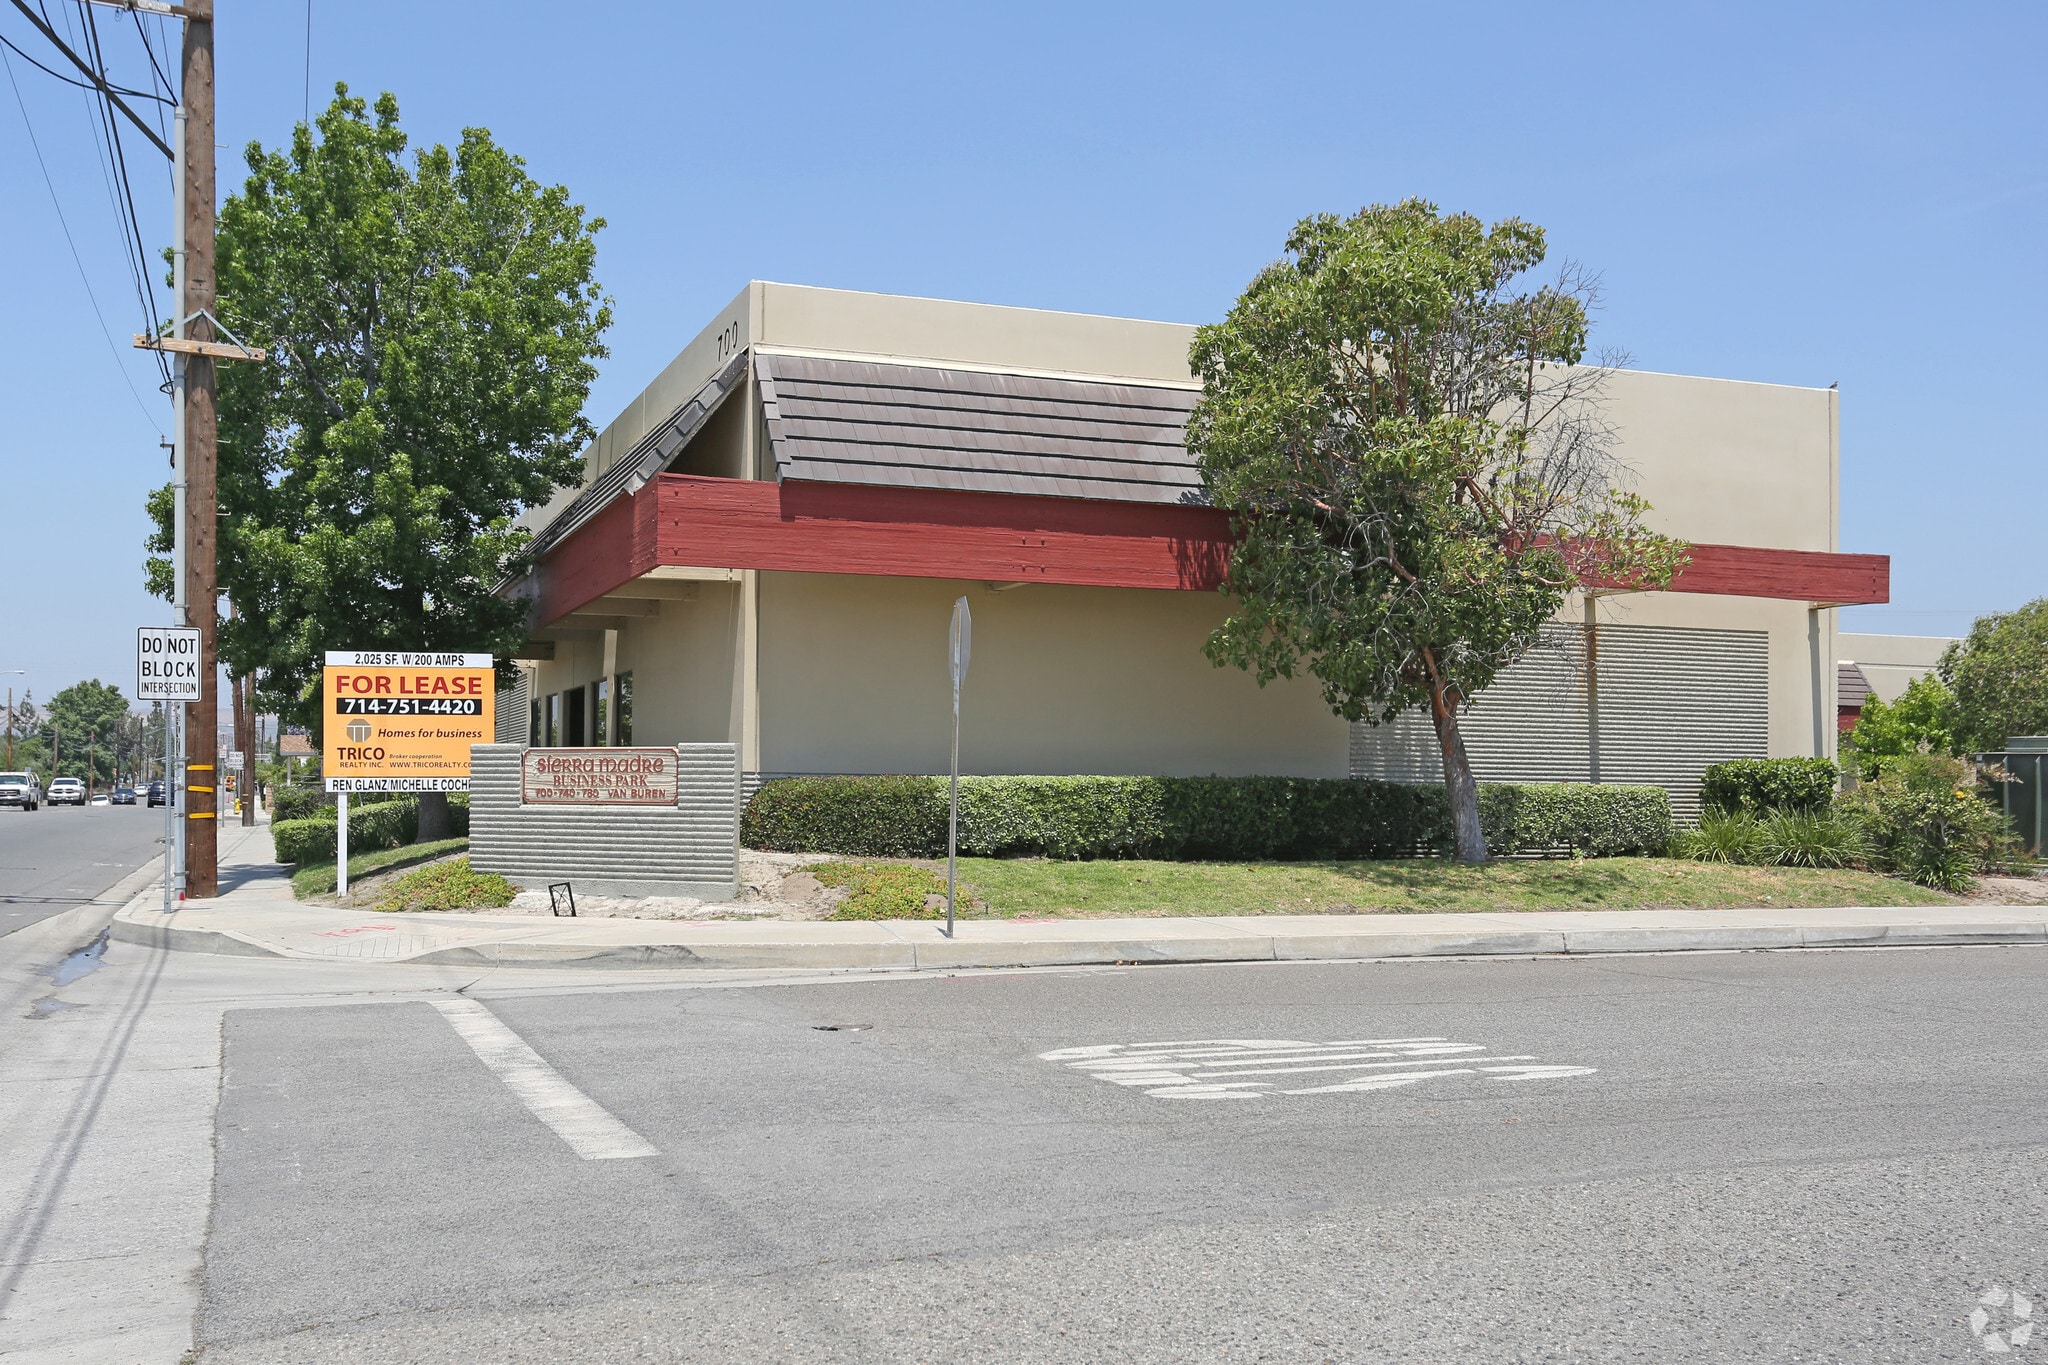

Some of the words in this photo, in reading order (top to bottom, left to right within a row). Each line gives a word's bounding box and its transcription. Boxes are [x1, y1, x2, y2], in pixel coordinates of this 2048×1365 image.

[717, 320, 738, 362] 700
[142, 637, 162, 653] DO
[167, 638, 196, 654] NOT
[354, 653, 382, 666] 2,025
[385, 653, 399, 665] SF.
[402, 654, 432, 666] W/200
[435, 654, 465, 666] AMPS
[142, 661, 196, 677] BLOCK
[141, 682, 197, 694] INTERSECTION
[336, 675, 391, 694] FOR
[399, 676, 482, 695] LEASE
[344, 698, 475, 715] 714-751-4420
[378, 728, 416, 739] Homes
[418, 728, 434, 739] for
[436, 728, 482, 739] business
[337, 747, 385, 760] TRICO
[332, 779, 352, 791] REN
[553, 774, 612, 787] BUSINESS
[615, 774, 648, 787] PARK
[607, 788, 627, 798] VAN
[631, 788, 666, 798] BUREN
